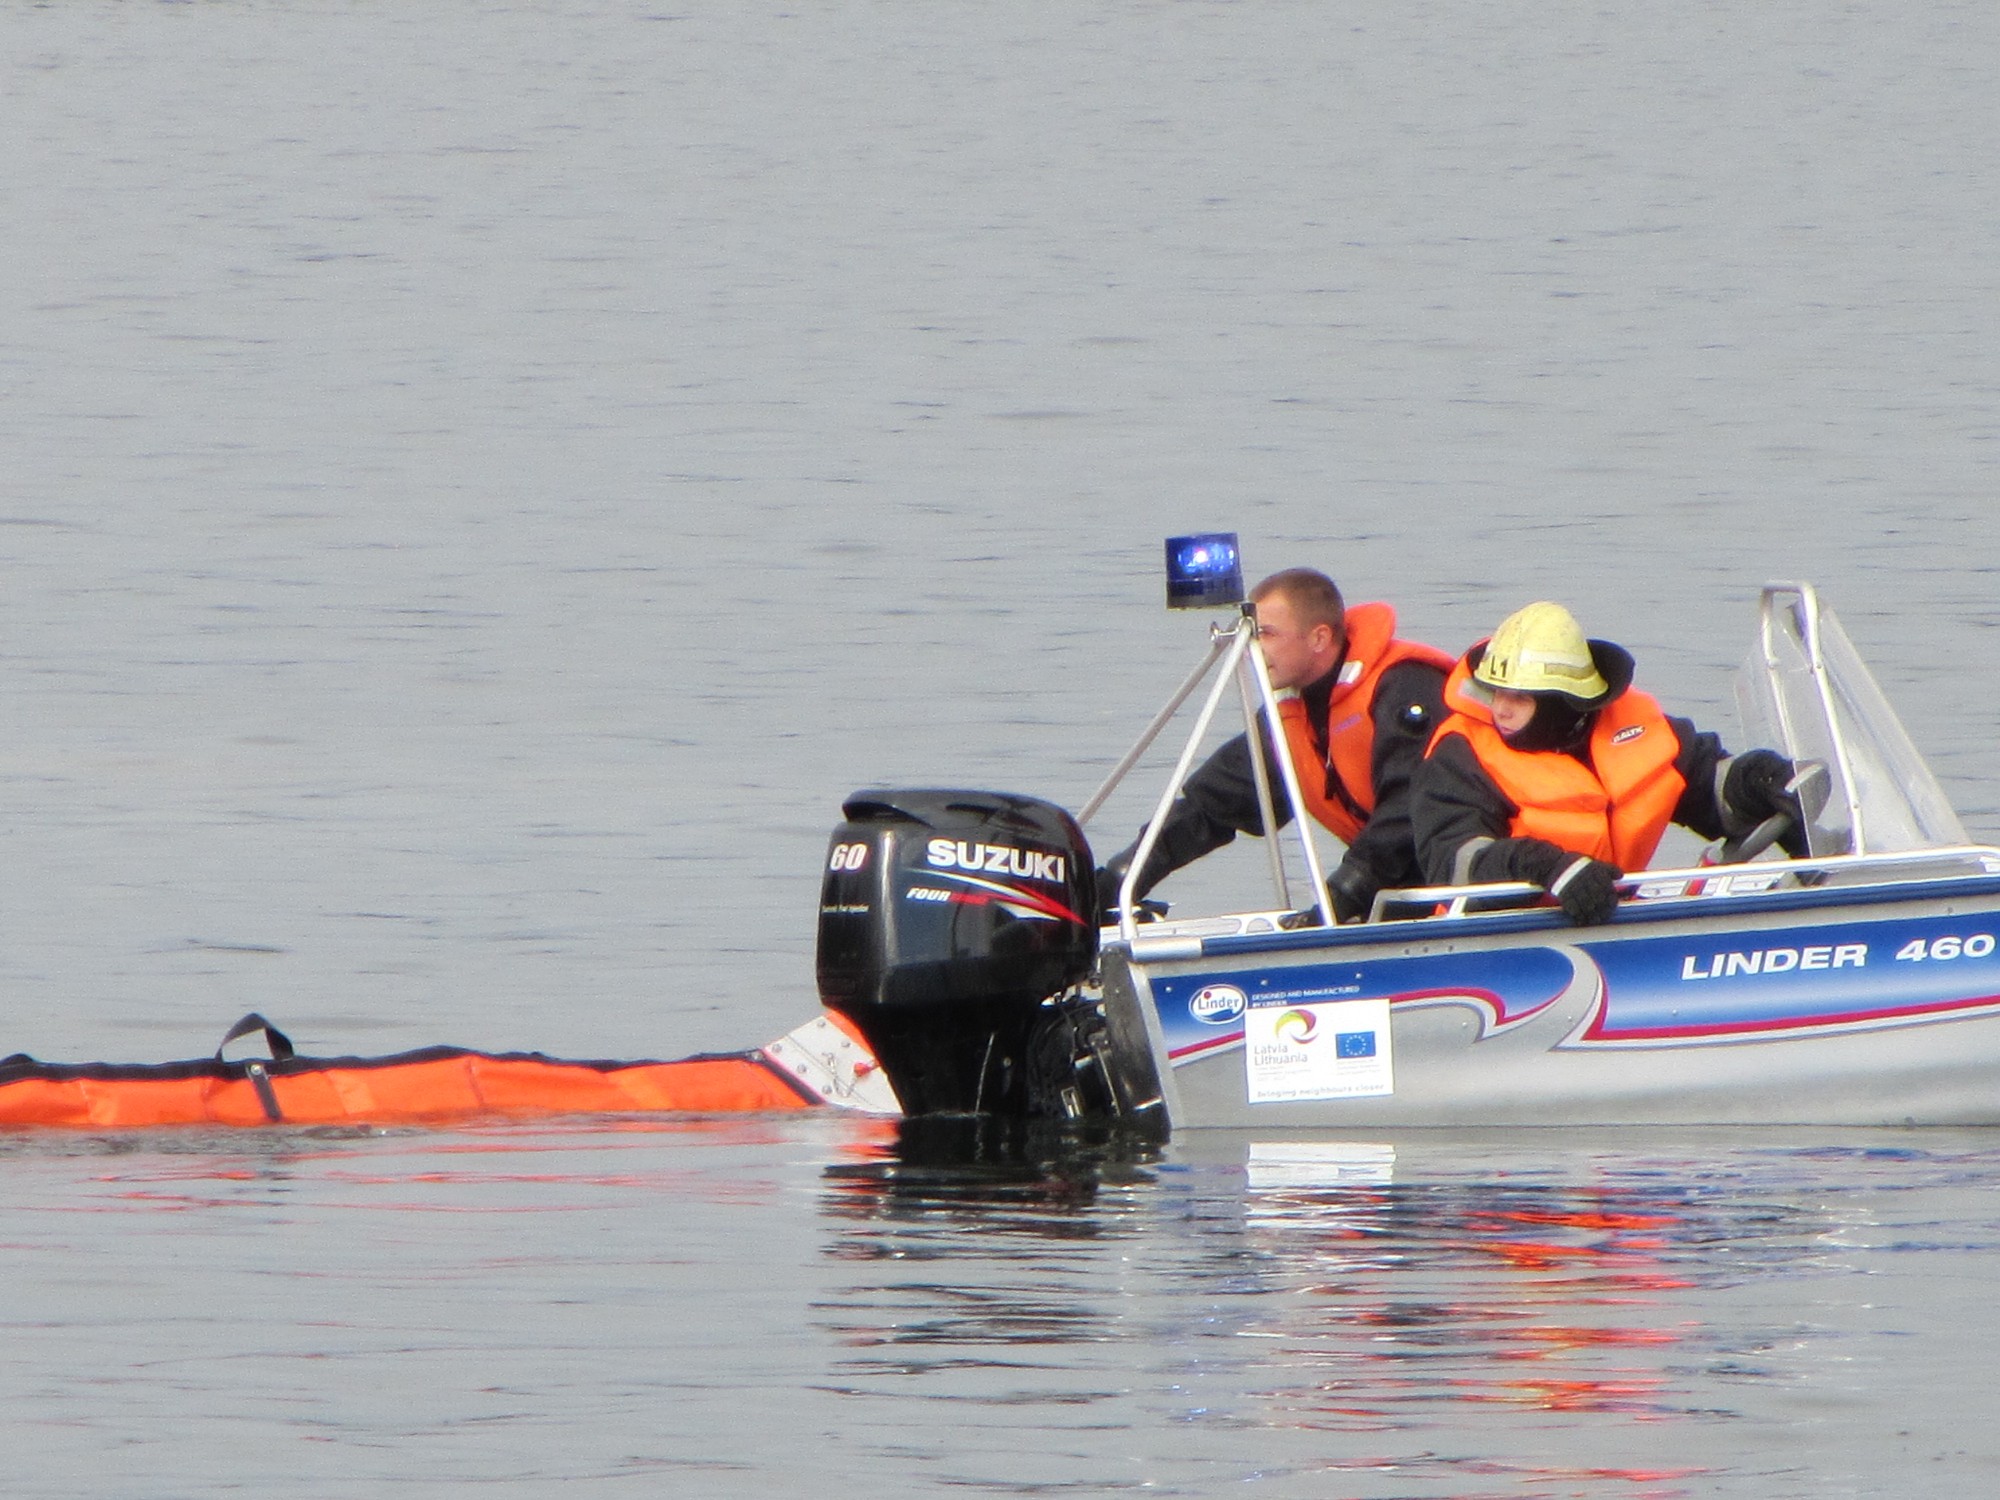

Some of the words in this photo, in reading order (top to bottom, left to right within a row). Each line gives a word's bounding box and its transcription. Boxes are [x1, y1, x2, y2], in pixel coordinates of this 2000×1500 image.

[1490, 655, 1508, 678] L1
[830, 843, 868, 871] 60
[926, 838, 1065, 883] SUZUKI
[906, 887, 951, 902] FOUR
[1681, 943, 1868, 981] LINDER
[1895, 933, 1996, 962] 460
[1198, 991, 1240, 1010] Linder
[1252, 992, 1286, 1001] DESIGNED
[1287, 990, 1302, 998] AND
[1303, 986, 1360, 996] MANUFACTURED
[1254, 1043, 1288, 1055] Latvia
[1254, 1052, 1309, 1067] Lithuania
[1355, 1083, 1385, 1092] closer
